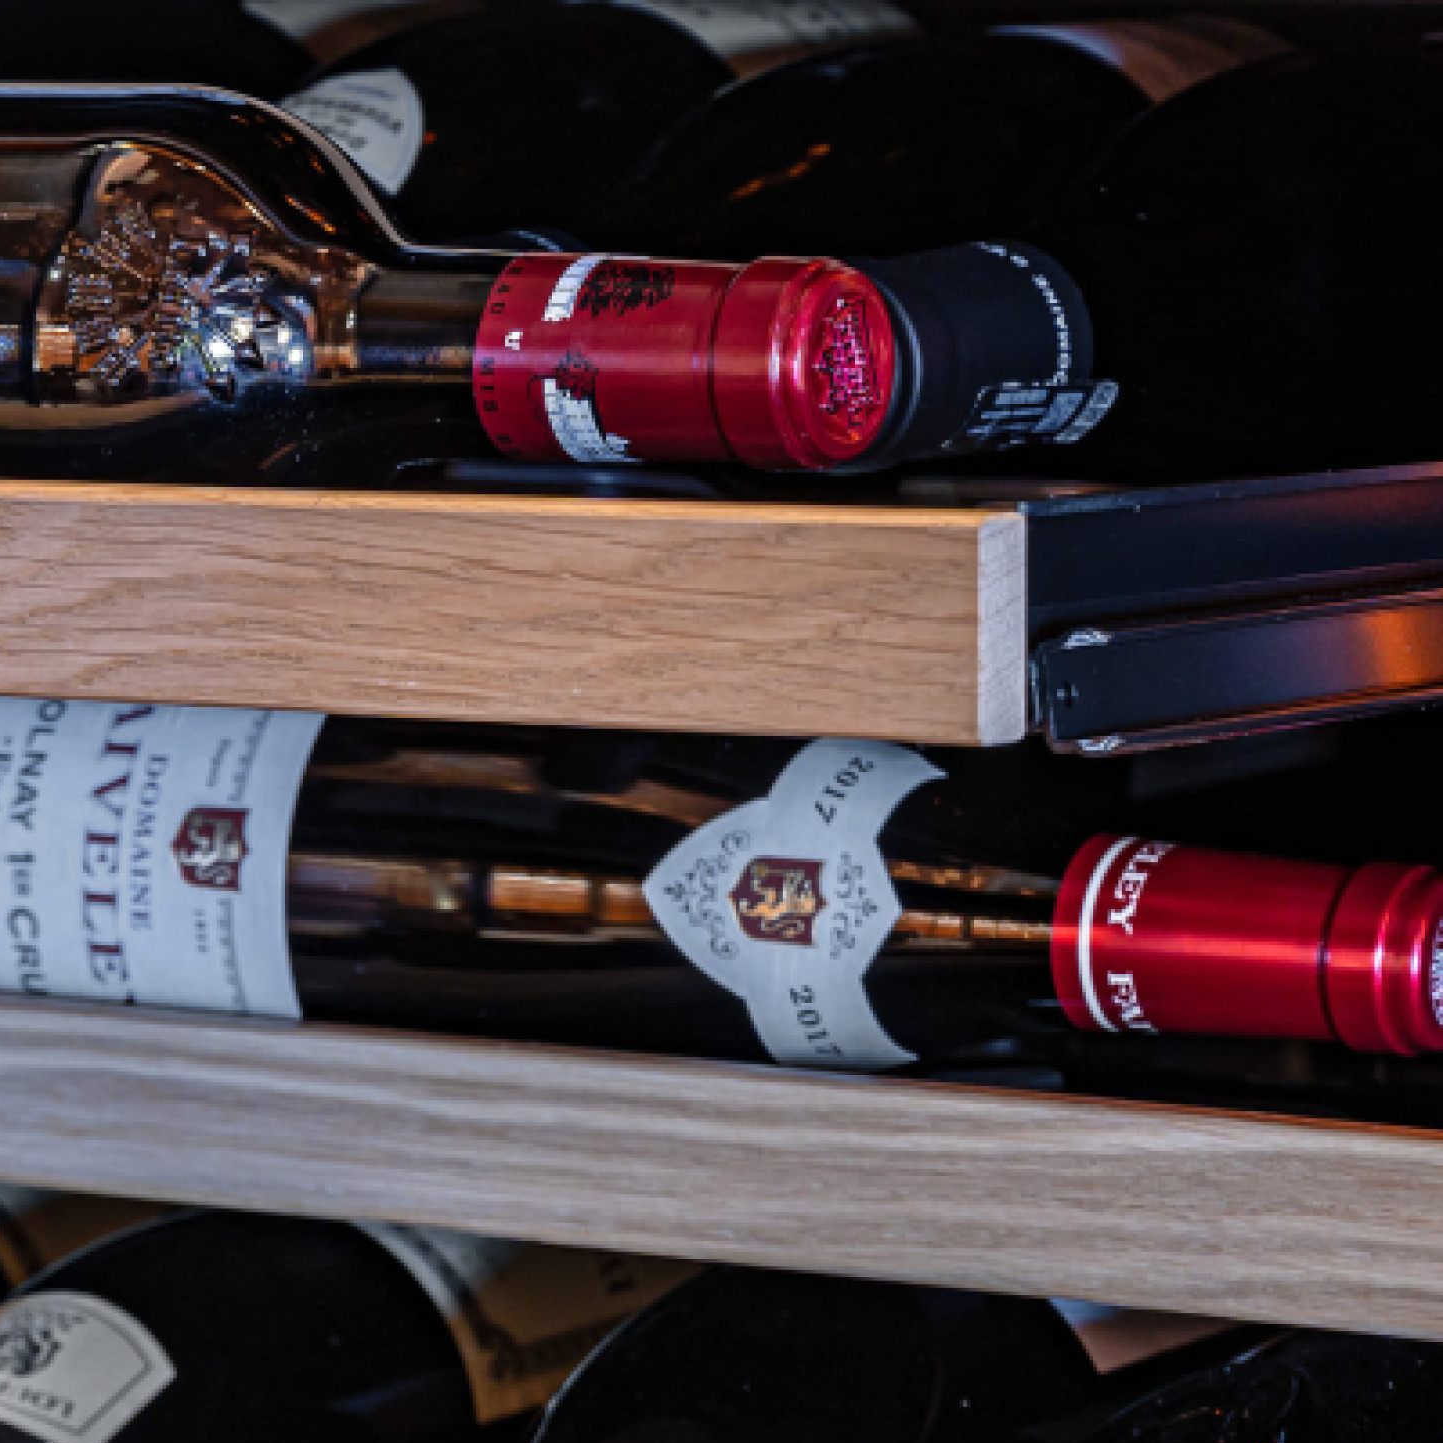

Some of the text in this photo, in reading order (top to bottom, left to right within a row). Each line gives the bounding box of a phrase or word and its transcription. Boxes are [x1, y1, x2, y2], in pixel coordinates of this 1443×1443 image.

[815, 754, 875, 826] 2017
[131, 754, 170, 932] DOMAINE
[5, 904, 49, 998] CRU
[789, 983, 843, 1059] 2017
